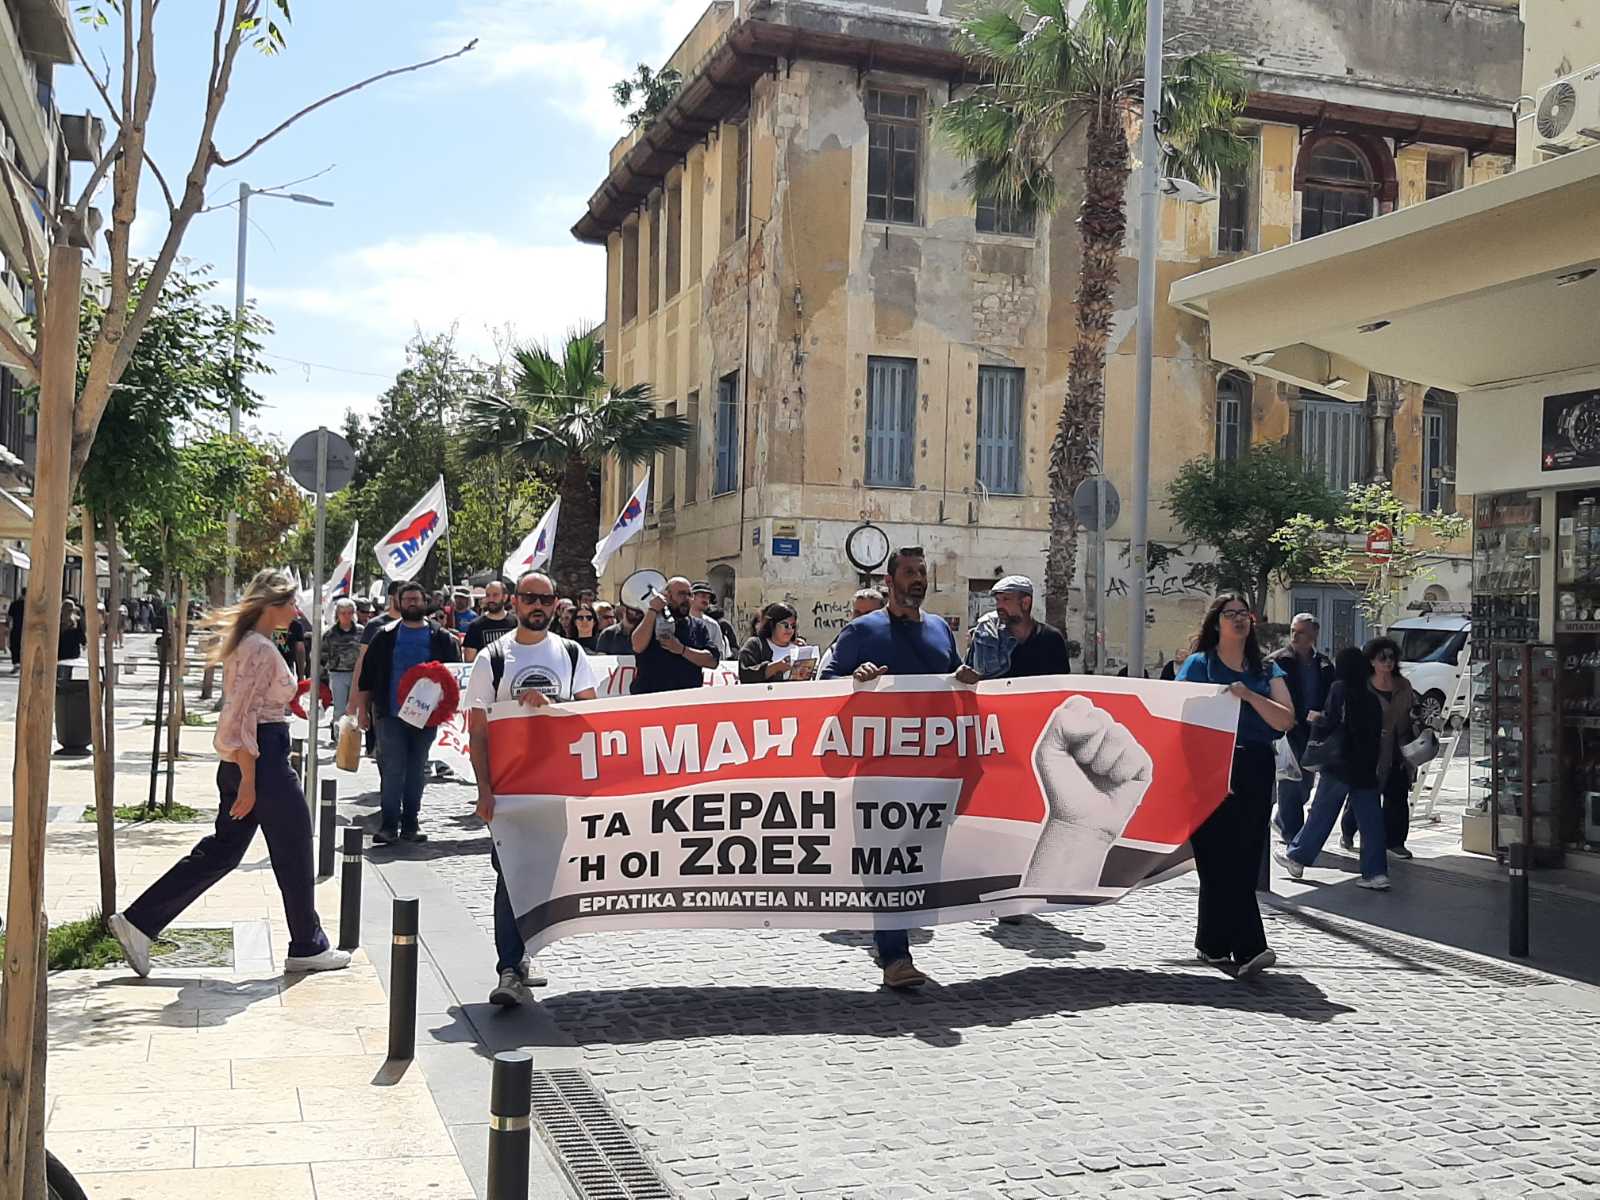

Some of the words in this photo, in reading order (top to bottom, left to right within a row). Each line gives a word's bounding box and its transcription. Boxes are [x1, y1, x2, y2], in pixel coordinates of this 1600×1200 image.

[639, 717, 798, 776] ΜΑΗ
[811, 714, 1005, 757] ΑΠΕΡΓΙΑ
[581, 812, 631, 839] ΤΑ
[651, 791, 836, 834] ΚΕΡΔΗ
[856, 801, 948, 830] ΤΟΥΣ
[620, 851, 660, 879] ΟΙ
[679, 835, 832, 876] ΖΩΕΣ
[851, 845, 924, 875] ΜΑΣ
[579, 893, 677, 913] ΕΡΓΑΤΙΚΑ
[682, 891, 787, 910] ΣΩΜΑΤΕΙΑ
[794, 891, 815, 907] Ν.
[820, 889, 926, 909] ΗΡΑΚΛΕΙΟΥ
